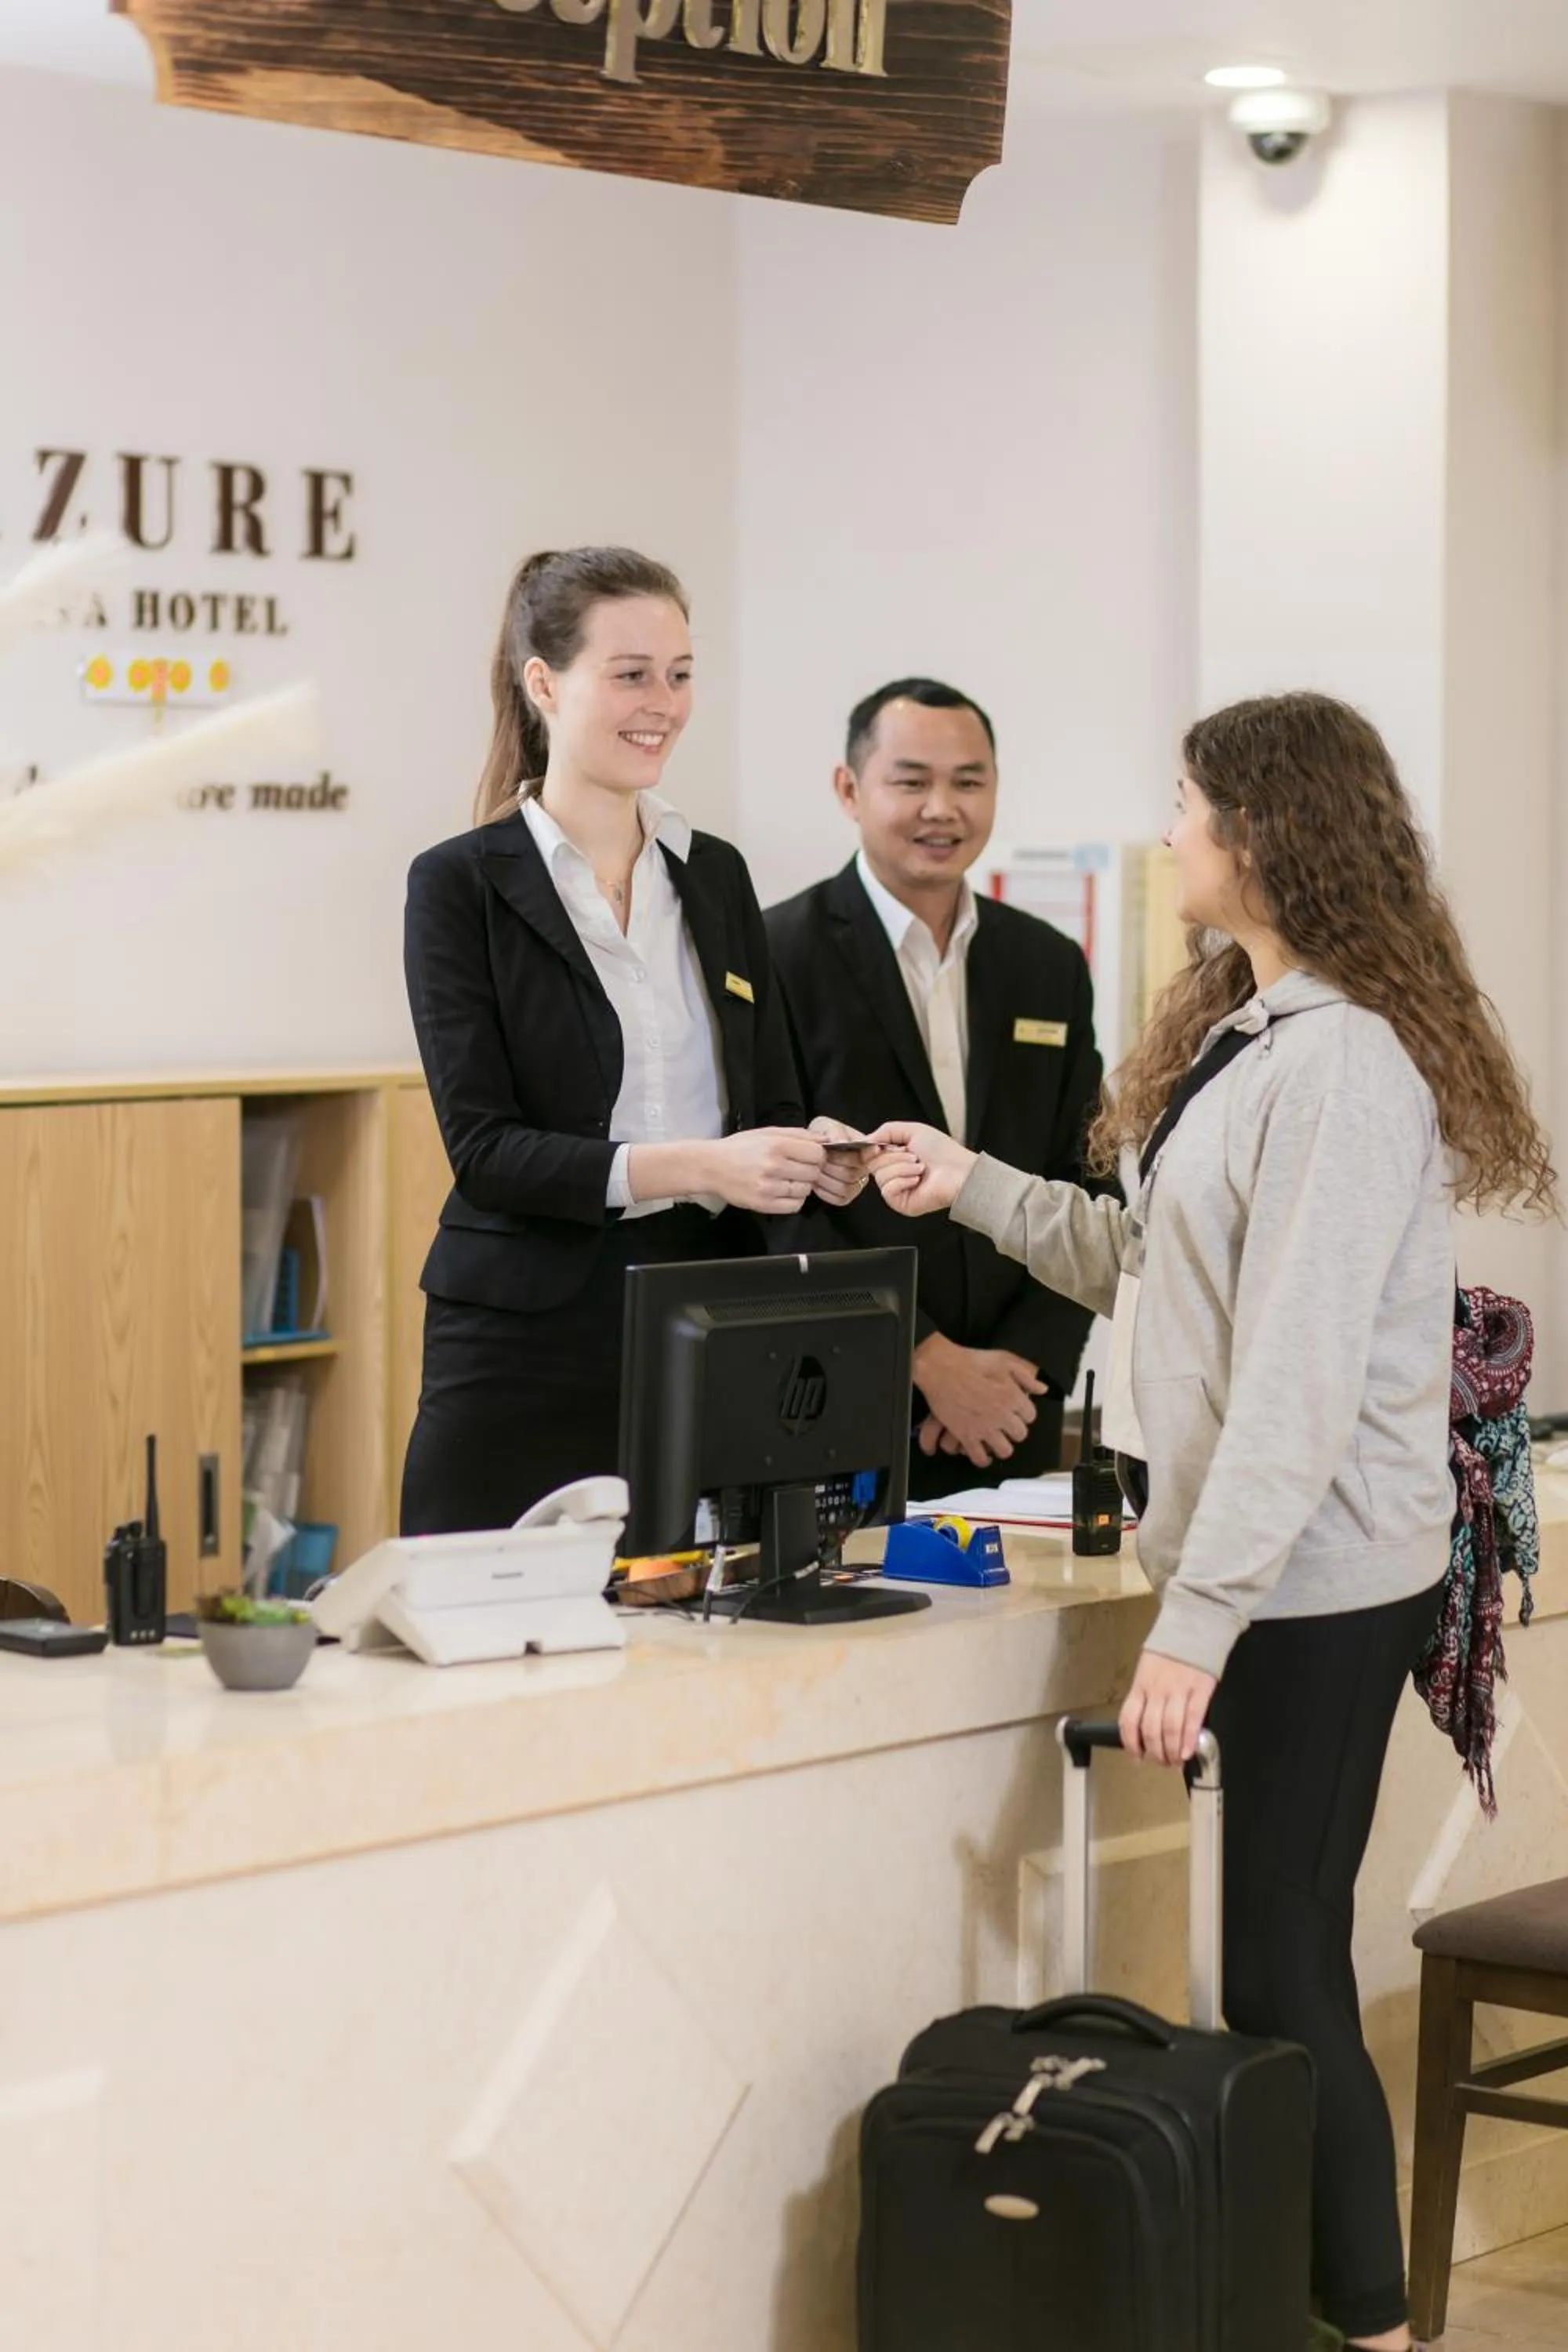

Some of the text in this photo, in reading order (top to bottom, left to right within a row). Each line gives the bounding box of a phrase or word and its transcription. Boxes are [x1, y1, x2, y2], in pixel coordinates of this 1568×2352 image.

[132, 588, 290, 636] HOTEL
[248, 769, 350, 811] made
[778, 1356, 826, 1437] hp
